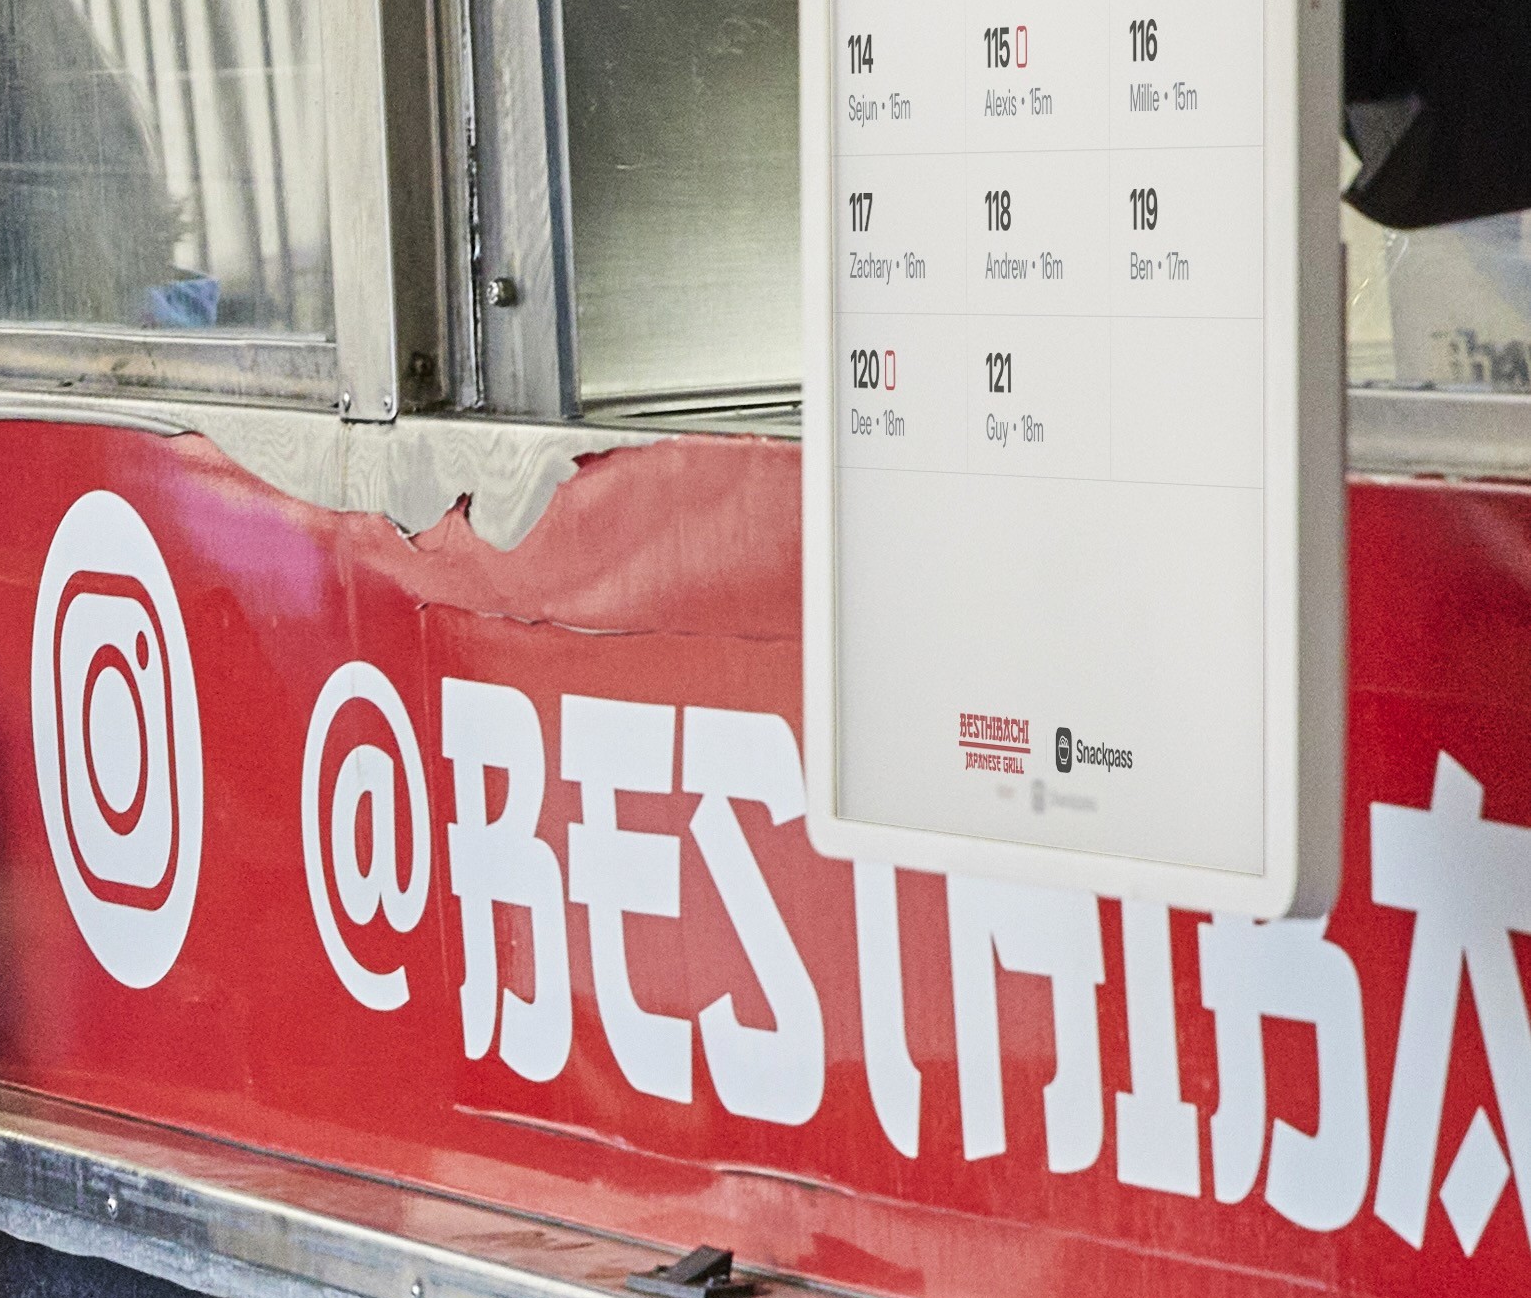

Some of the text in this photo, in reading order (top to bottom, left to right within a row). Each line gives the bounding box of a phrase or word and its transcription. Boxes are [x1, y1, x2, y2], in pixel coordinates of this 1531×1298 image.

[848, 34, 873, 74] 114
[984, 27, 1010, 68] 115
[1130, 19, 1157, 62] 116
[849, 93, 910, 127] Sejun 15m
[985, 87, 1052, 116] Alexis 15m
[1130, 82, 1197, 111] Millie 15m
[849, 193, 872, 231] 117
[985, 190, 1011, 231] 118
[1130, 188, 1158, 230] 119
[850, 252, 925, 285] Zachary 16m
[985, 252, 1063, 279] Andrew 16m
[1131, 252, 1189, 280] Ben 17m
[851, 350, 879, 389] 120
[986, 353, 1011, 393] 121
[851, 408, 904, 436] Dee 18m
[986, 413, 1043, 448] Guy 18m
[960, 713, 1029, 744] BESTHIBACHI
[966, 752, 1024, 774] JAPANESE GRILL
[1076, 739, 1133, 772] Snackpass
